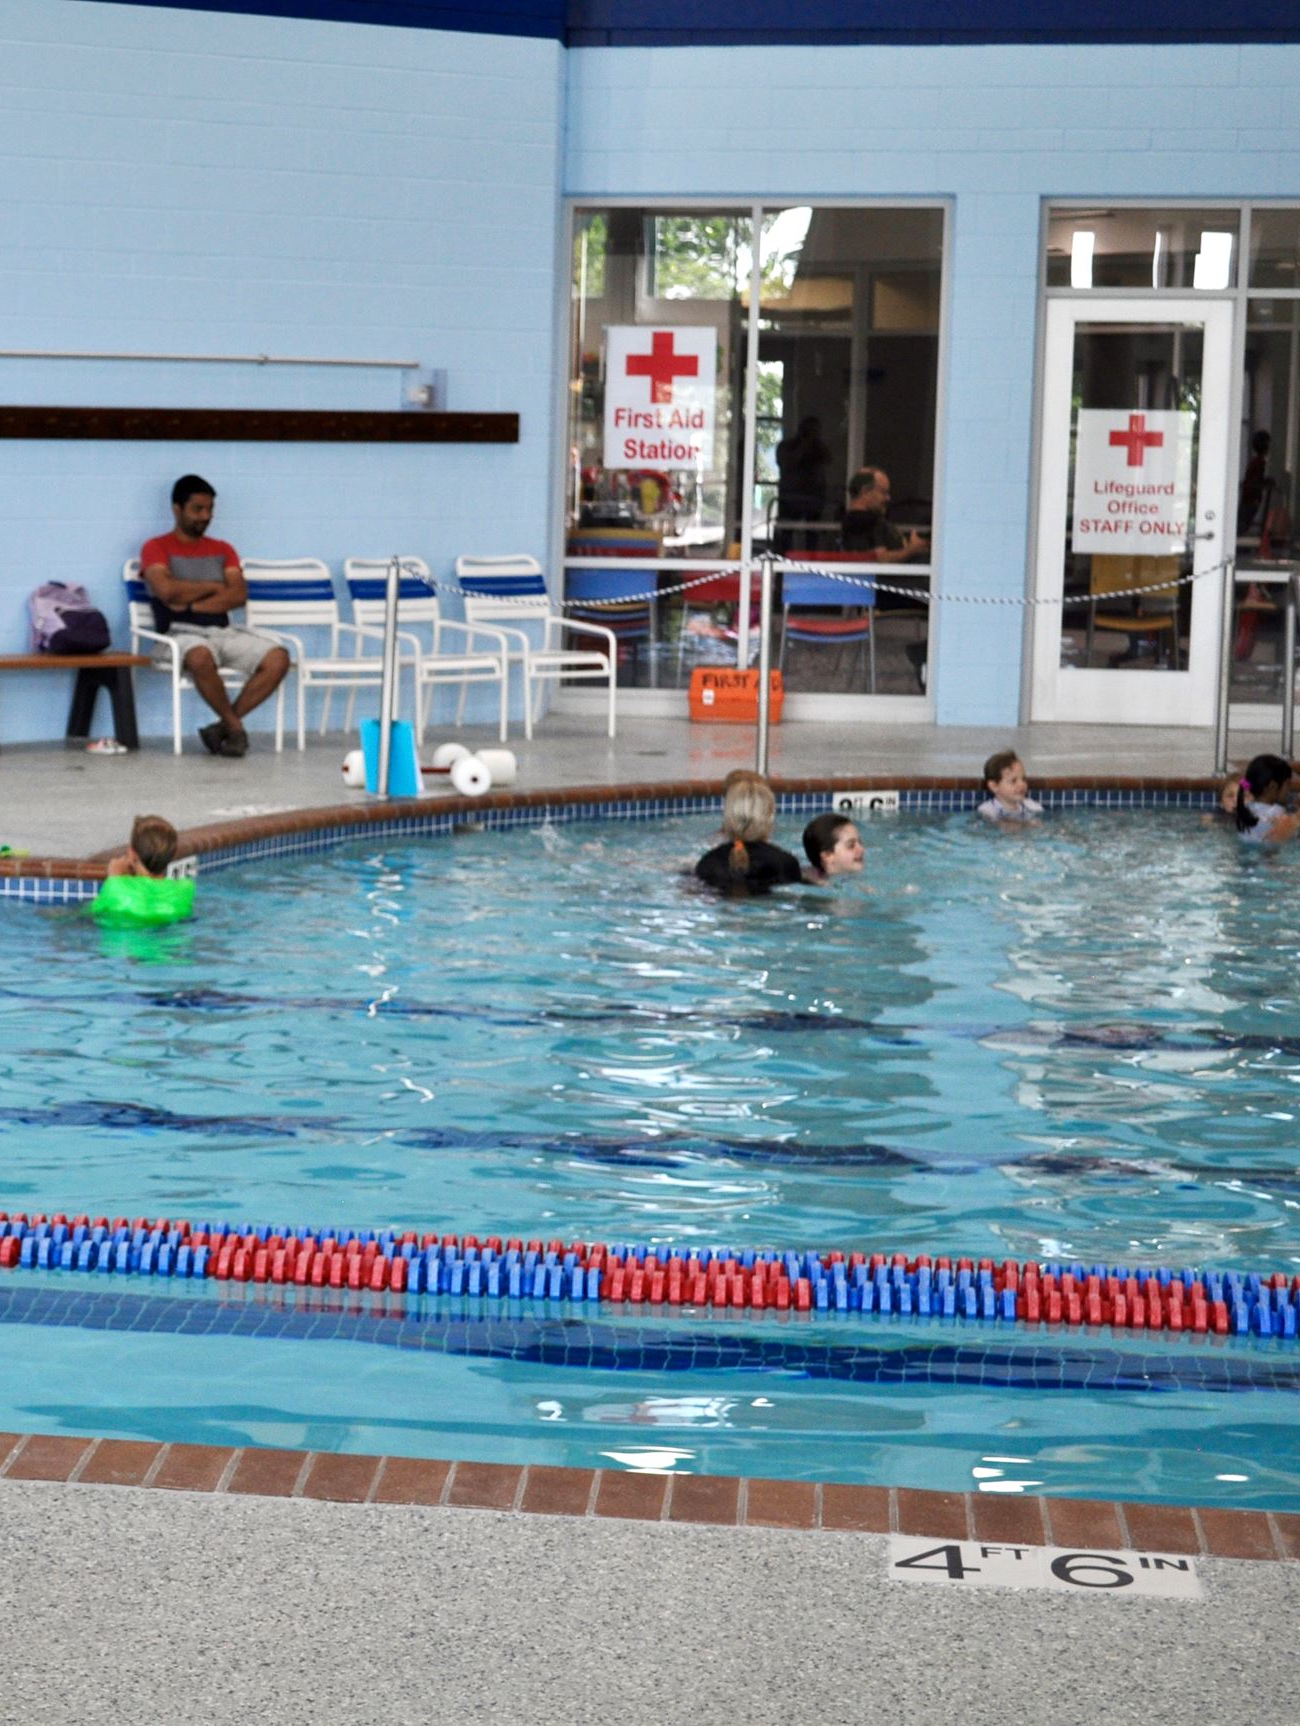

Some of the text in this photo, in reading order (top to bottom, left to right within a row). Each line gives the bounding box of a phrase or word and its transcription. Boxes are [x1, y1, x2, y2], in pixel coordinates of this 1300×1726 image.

[614, 408, 704, 428] First Aid
[1094, 480, 1175, 497] Lifeguard
[1108, 500, 1159, 514] Office
[1080, 519, 1184, 535] STAFF ONLY
[702, 674, 750, 688] FIRST
[895, 1545, 1190, 1588] 4 FT 6 IN
